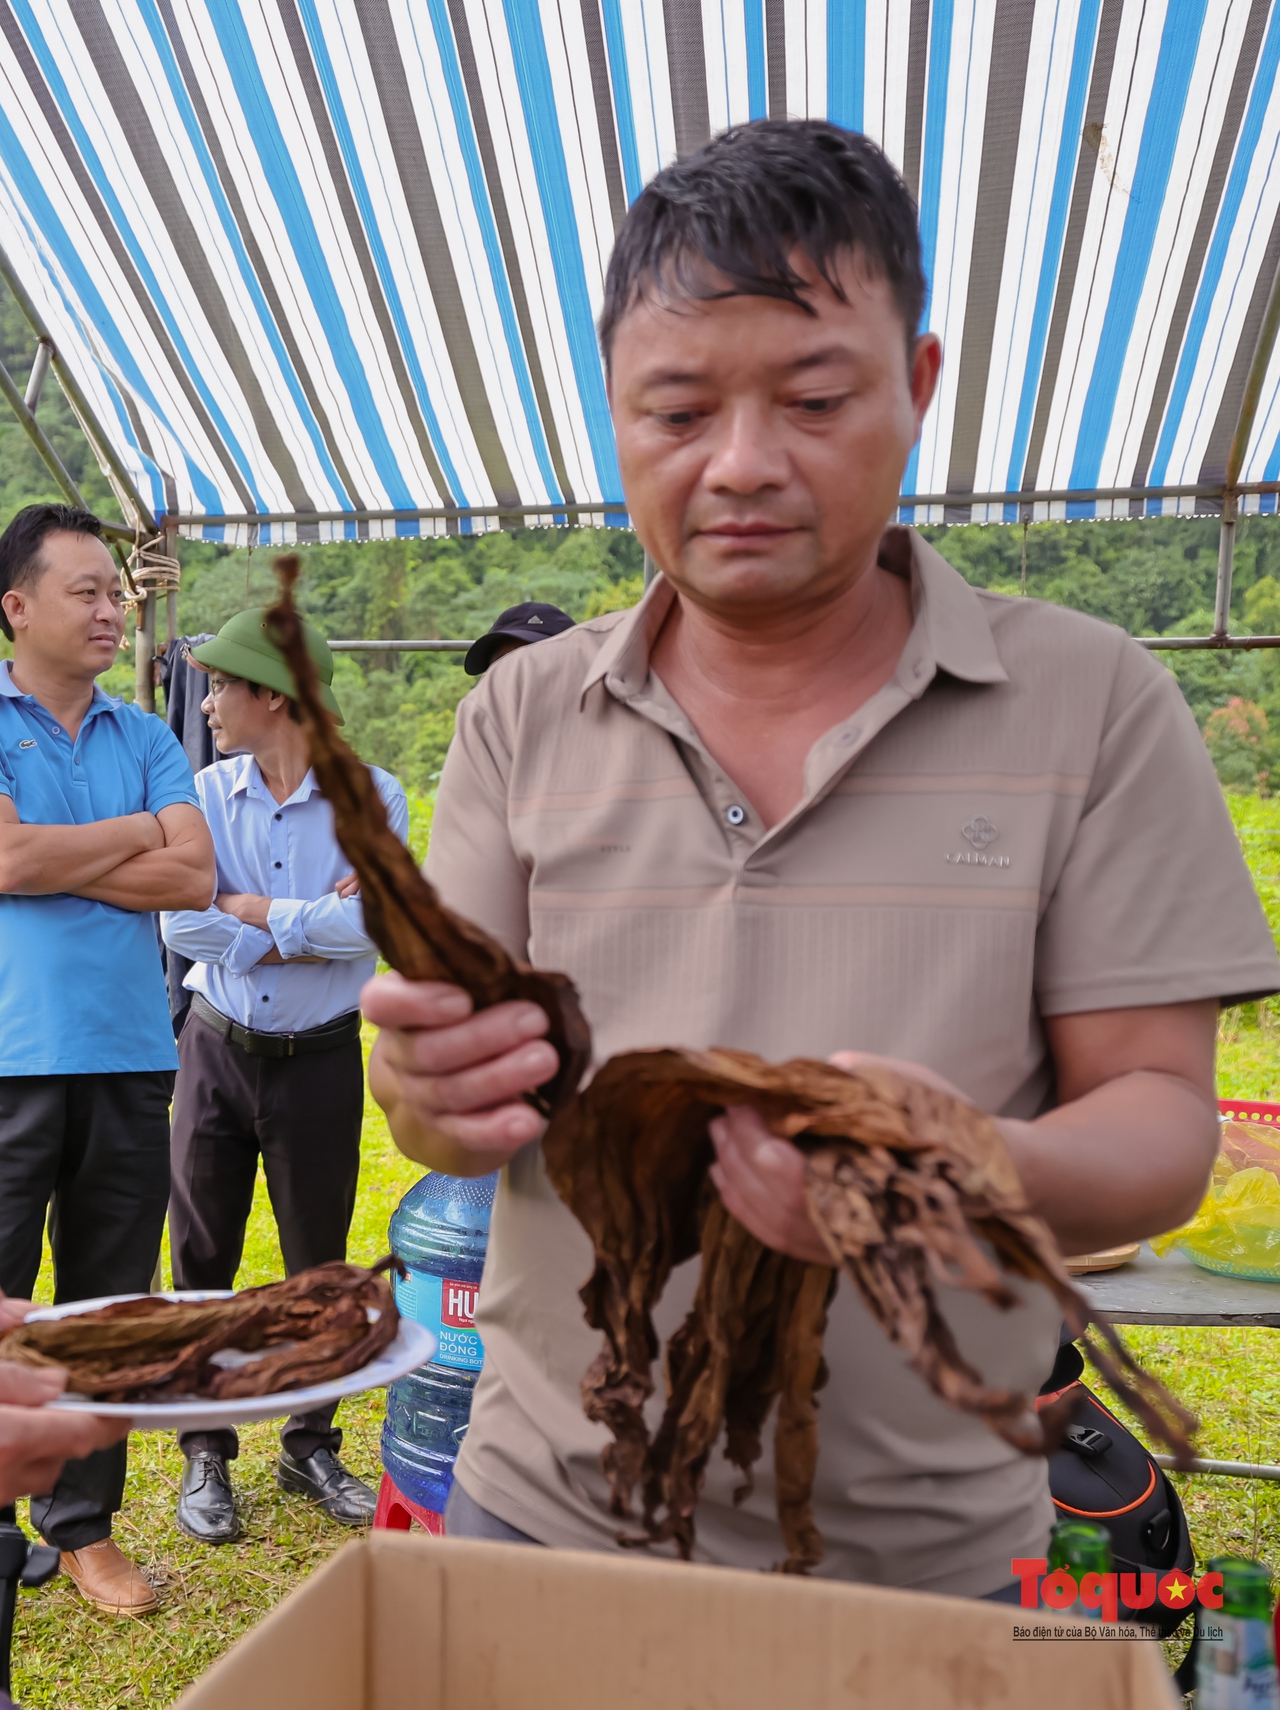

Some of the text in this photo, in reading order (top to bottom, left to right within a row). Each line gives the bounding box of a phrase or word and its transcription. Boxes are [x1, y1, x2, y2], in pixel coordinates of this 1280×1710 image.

[440, 1330, 478, 1346] NƯỚC
[439, 1341, 477, 1357] ĐÓNG
[439, 1353, 468, 1364] DRINKING
